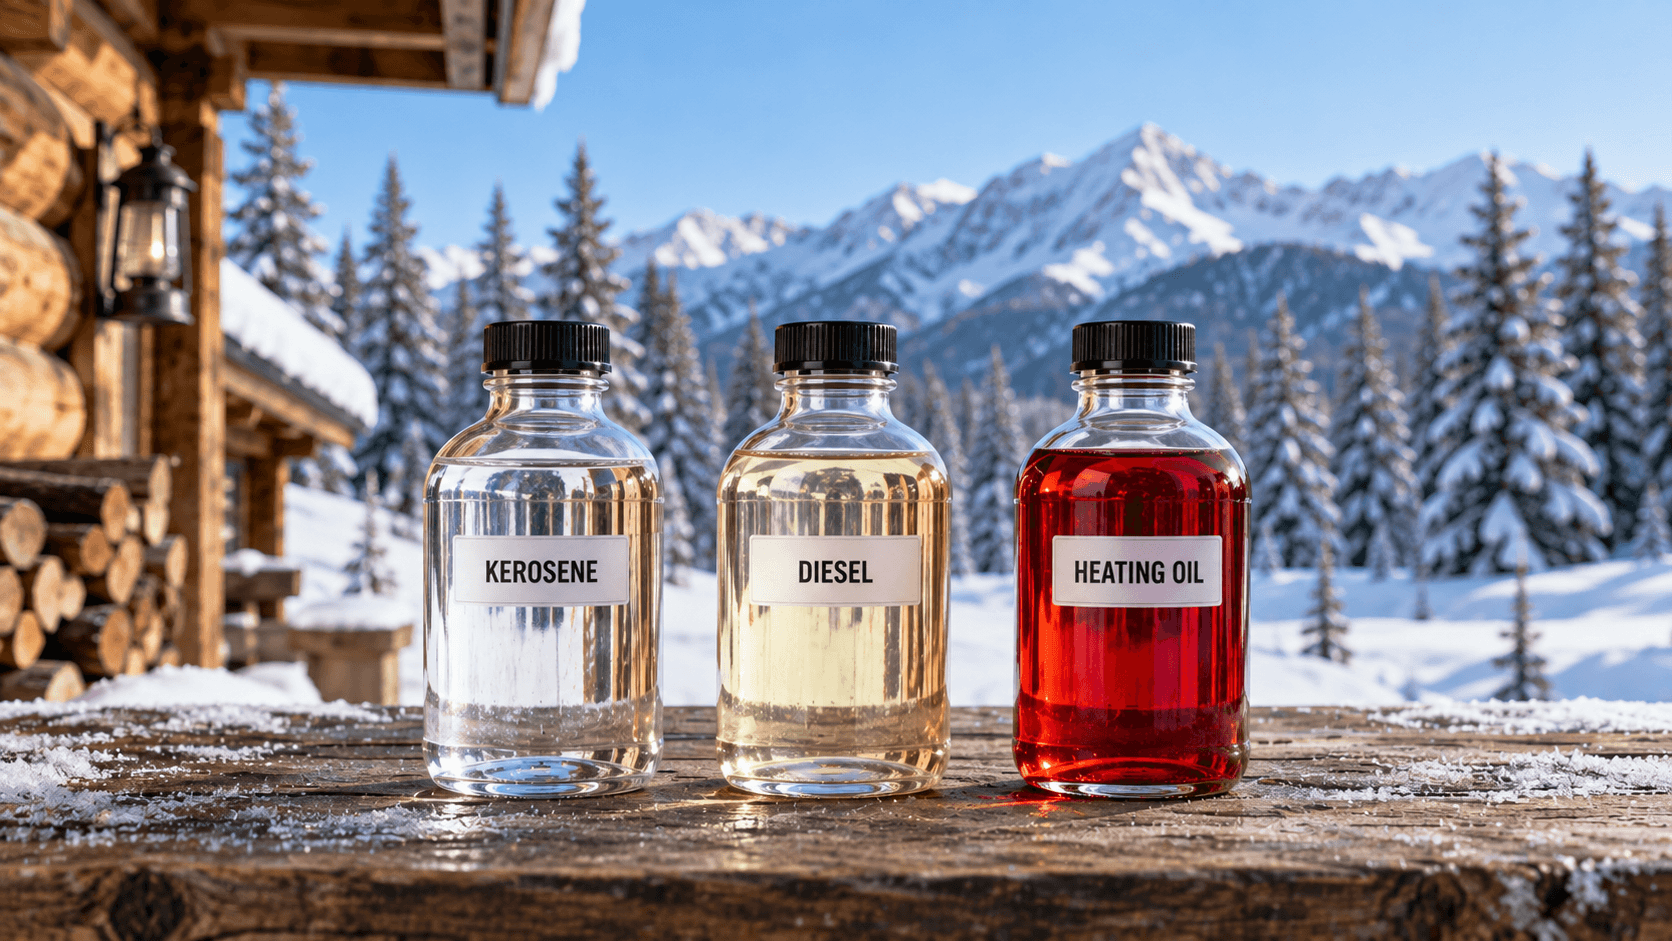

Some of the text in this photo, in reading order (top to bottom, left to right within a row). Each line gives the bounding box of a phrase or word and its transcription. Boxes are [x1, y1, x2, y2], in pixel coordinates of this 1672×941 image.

[485, 560, 598, 584] KEROSENE
[798, 561, 874, 584] DIESEL
[1074, 561, 1204, 585] HEATING OIL
